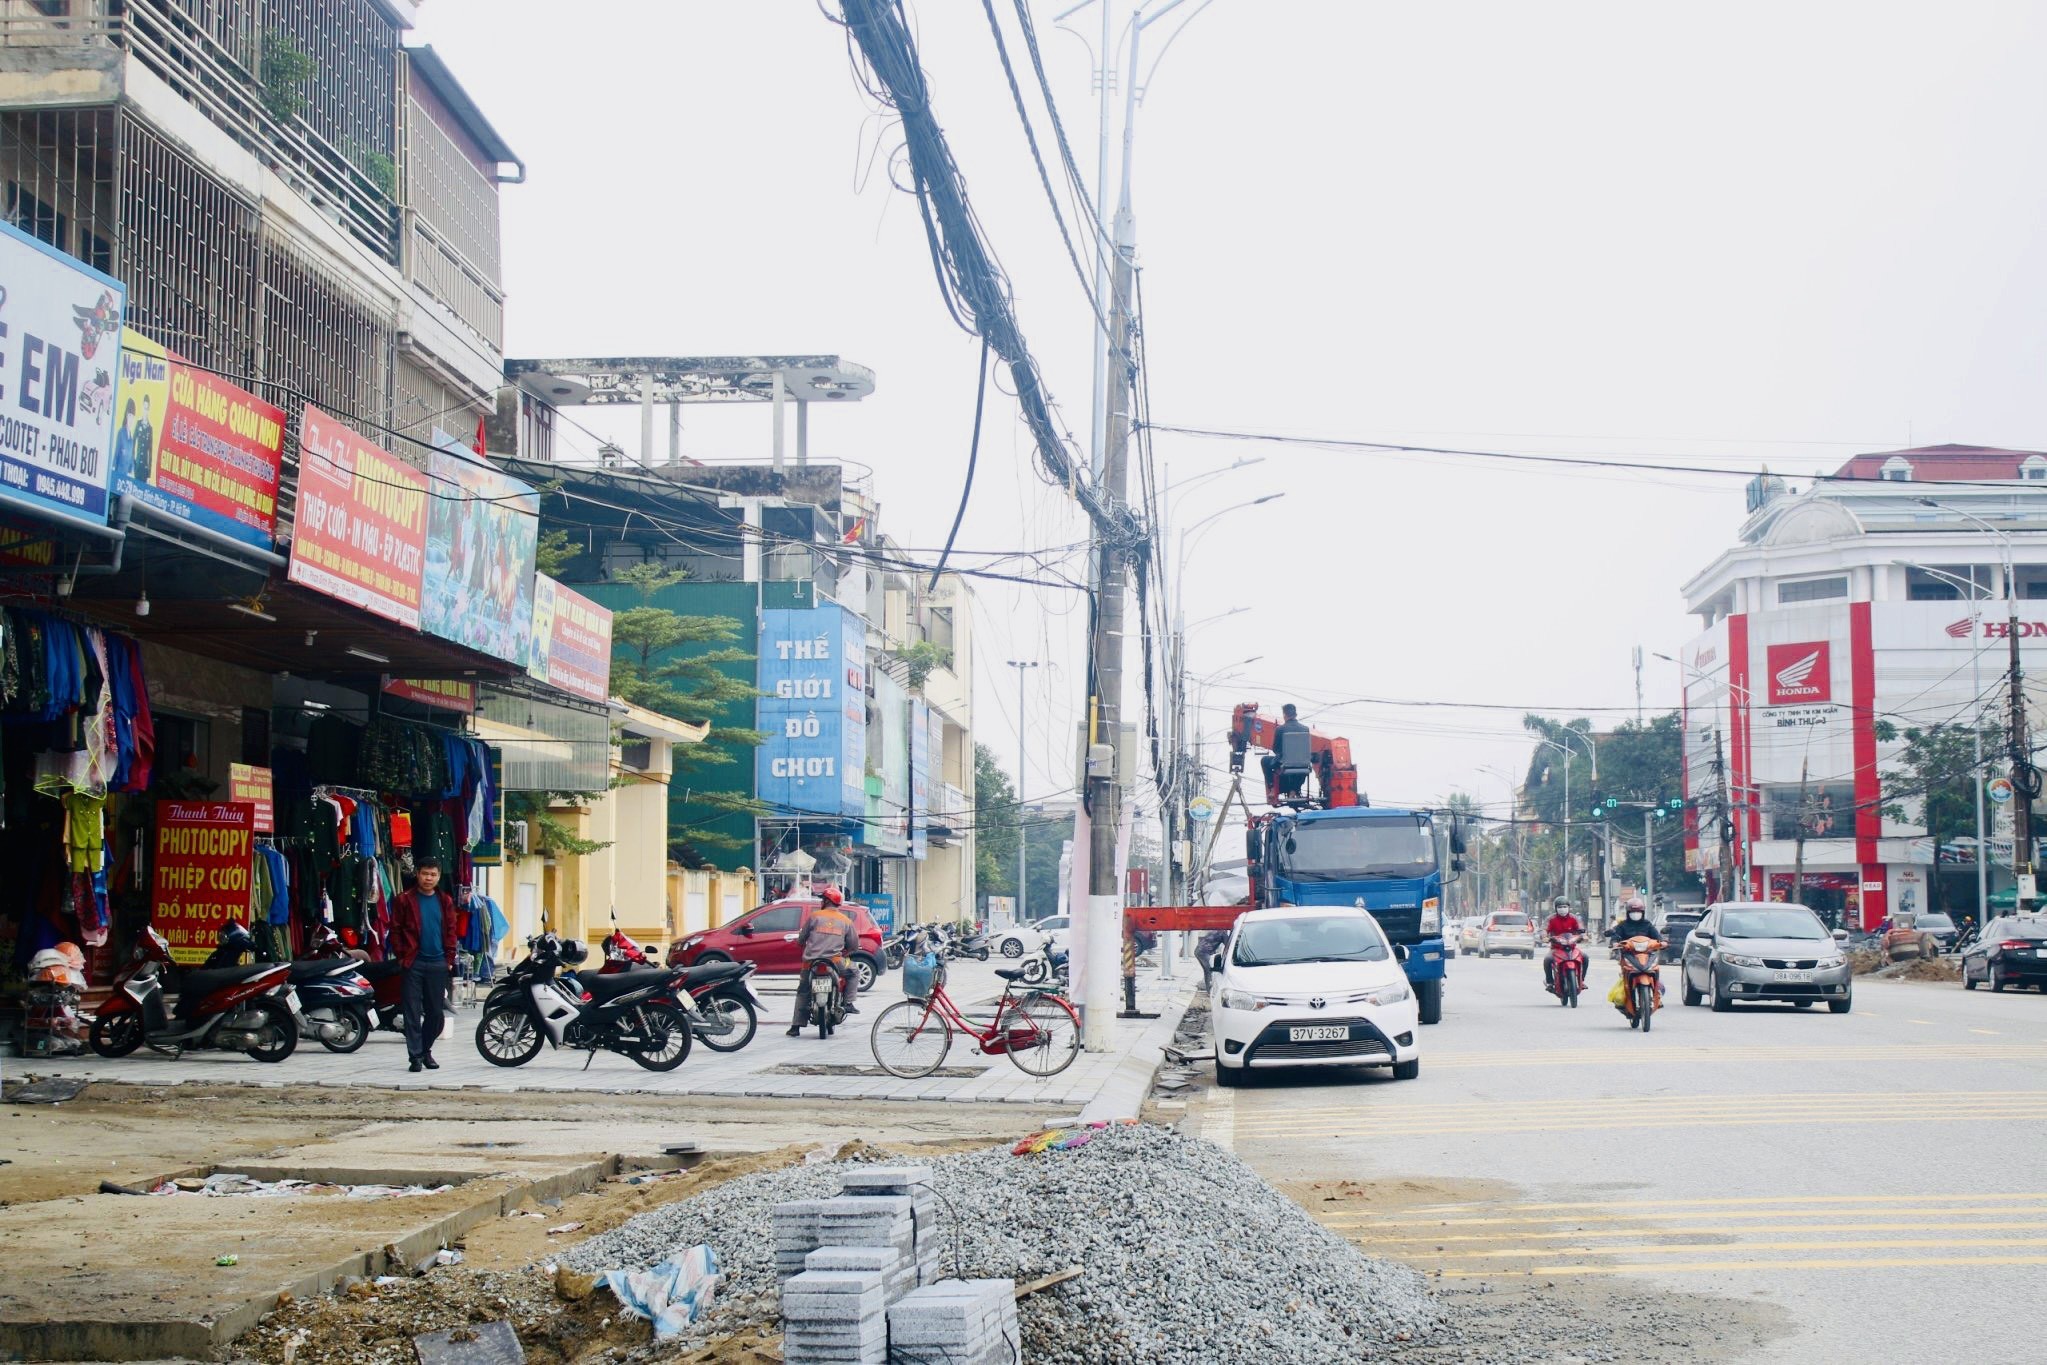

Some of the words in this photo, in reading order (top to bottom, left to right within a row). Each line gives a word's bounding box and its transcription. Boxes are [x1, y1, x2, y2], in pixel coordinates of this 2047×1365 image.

[19, 332, 80, 428] EM
[144, 357, 165, 381] Nam
[195, 380, 228, 426] HÀNG
[229, 400, 259, 442] QUÂN
[49, 433, 79, 472] PHAO
[354, 447, 426, 535] PHOTOCOPY
[302, 488, 327, 537] THIỆP
[351, 516, 362, 549] IN
[394, 537, 422, 577] PLASTIC
[776, 631, 830, 660] THẾ
[776, 673, 832, 699] GIỚI
[1776, 686, 1820, 696] HONDA
[785, 710, 820, 738] ĐỒ
[772, 757, 835, 778] CHƠI
[168, 804, 208, 819] Thanh
[160, 826, 249, 857] PHOTOCOPY
[160, 862, 205, 895] THIỆP
[209, 863, 247, 891] CƯỚI
[185, 902, 222, 923] MỰC
[167, 926, 189, 944] MÀU
[195, 926, 206, 945] ÉP
[1292, 1027, 1346, 1041] 37V-3267
